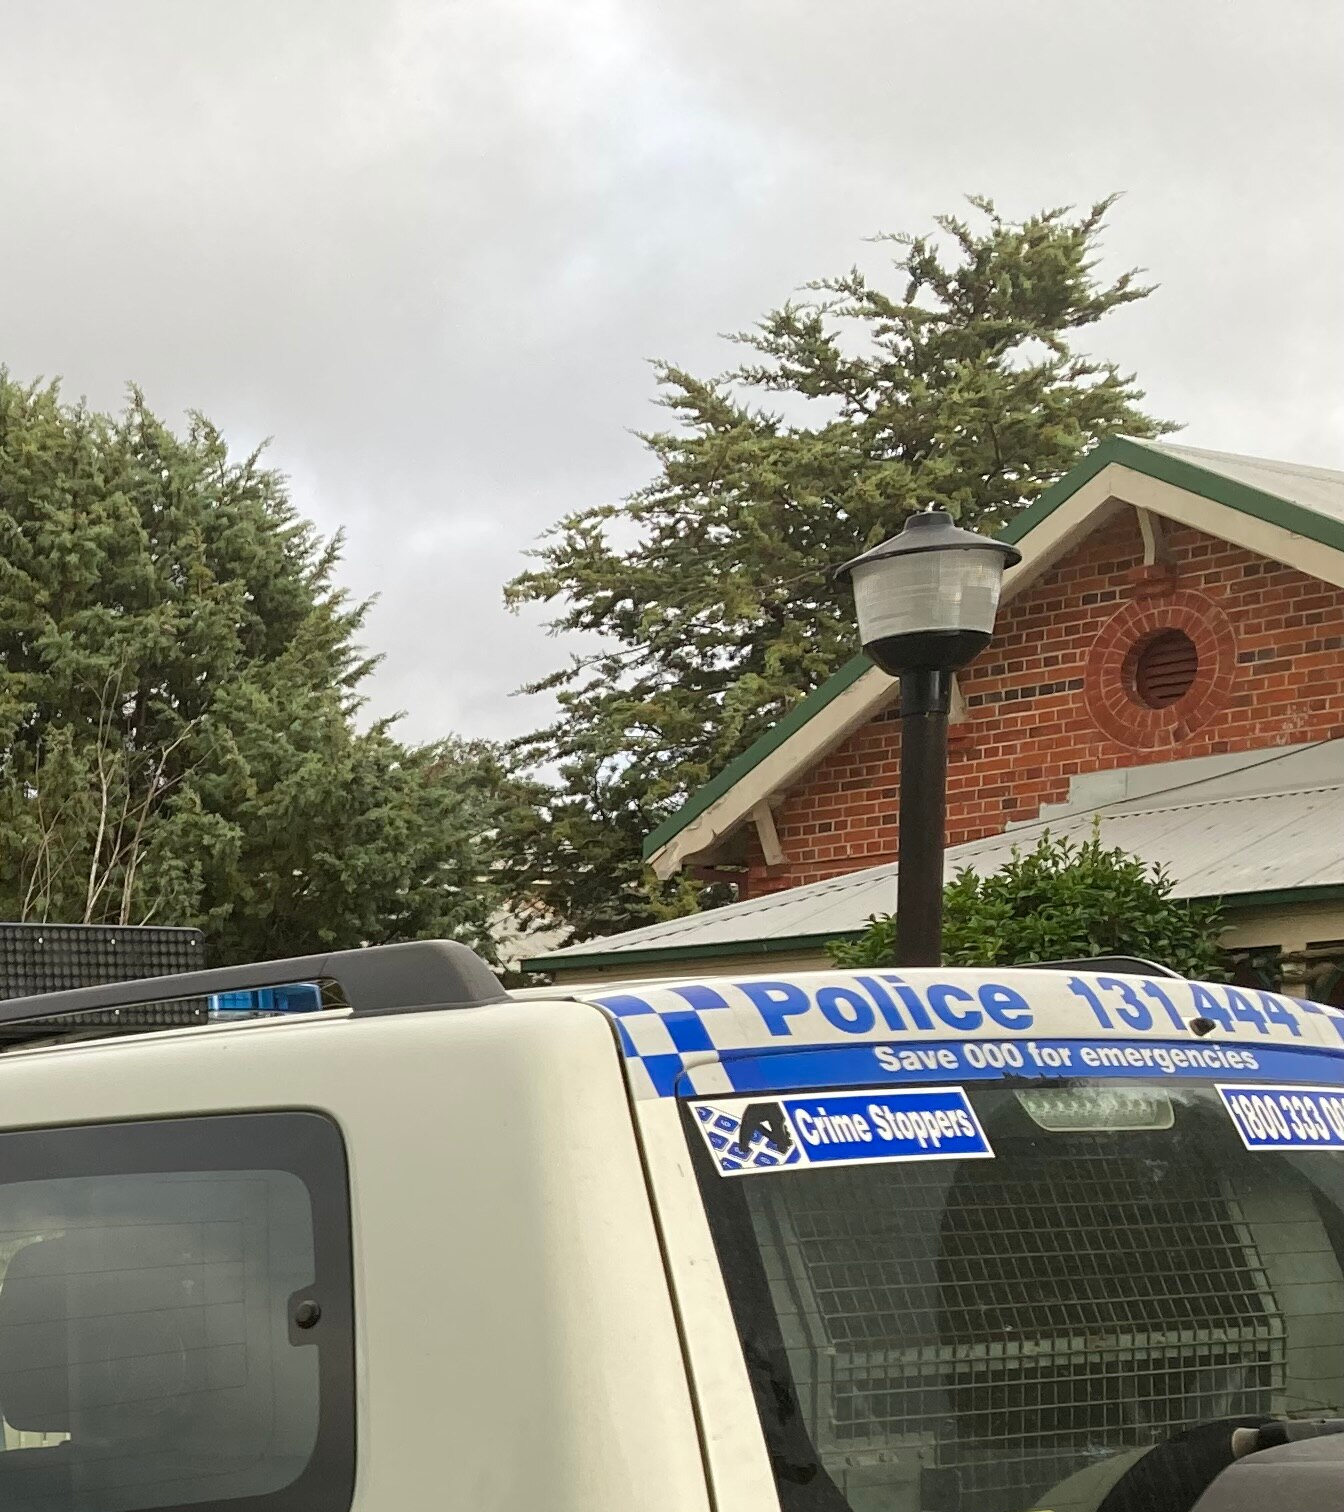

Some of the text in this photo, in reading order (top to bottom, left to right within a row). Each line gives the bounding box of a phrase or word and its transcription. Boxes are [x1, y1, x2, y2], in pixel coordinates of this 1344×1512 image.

[733, 974, 1033, 1037] Police
[1067, 976, 1188, 1031] 131
[874, 1042, 1260, 1073] Save 000 for emergencies
[794, 1108, 871, 1146] Crime
[866, 1103, 976, 1148] Stoppers
[1230, 1094, 1292, 1141] 1800
[1279, 1095, 1331, 1141] 333
